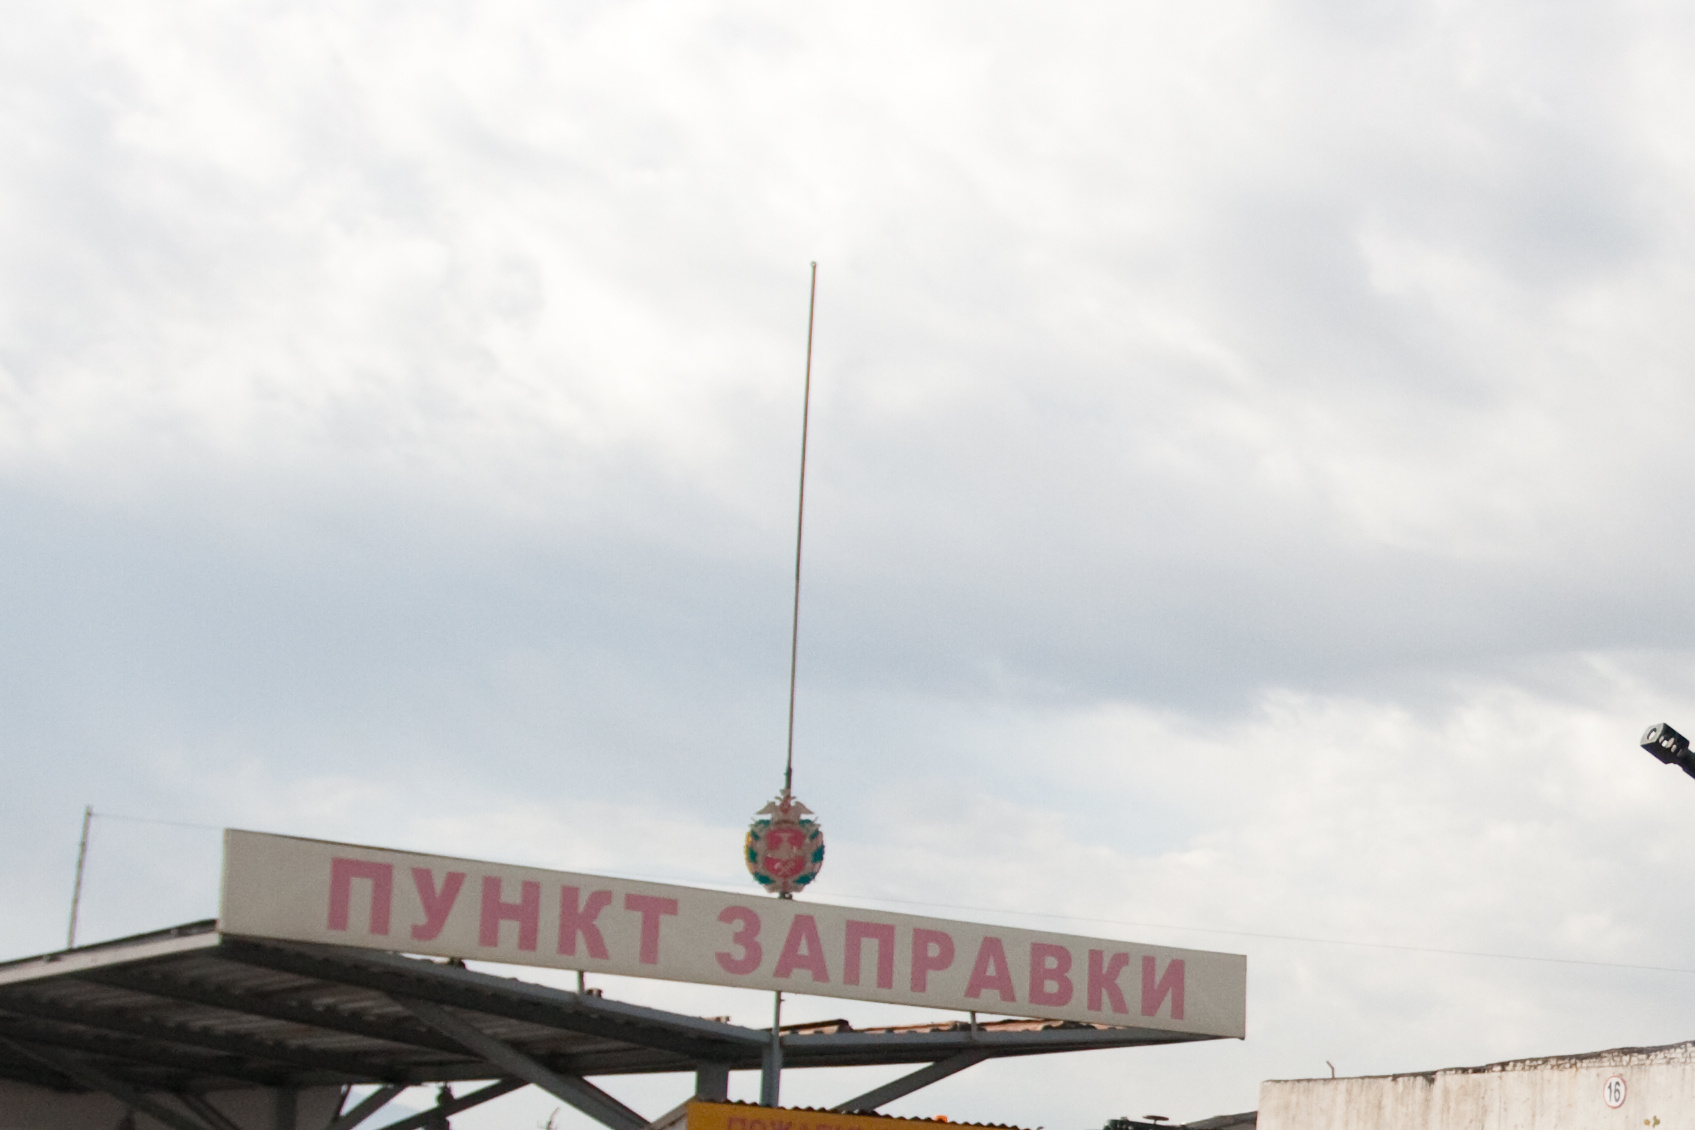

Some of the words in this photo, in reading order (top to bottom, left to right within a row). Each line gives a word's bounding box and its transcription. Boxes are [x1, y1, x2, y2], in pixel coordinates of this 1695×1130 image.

[327, 857, 679, 965] ПУНКТ
[715, 904, 1186, 1020] ЗАПРАВКИ
[1608, 1081, 1620, 1102] 16
